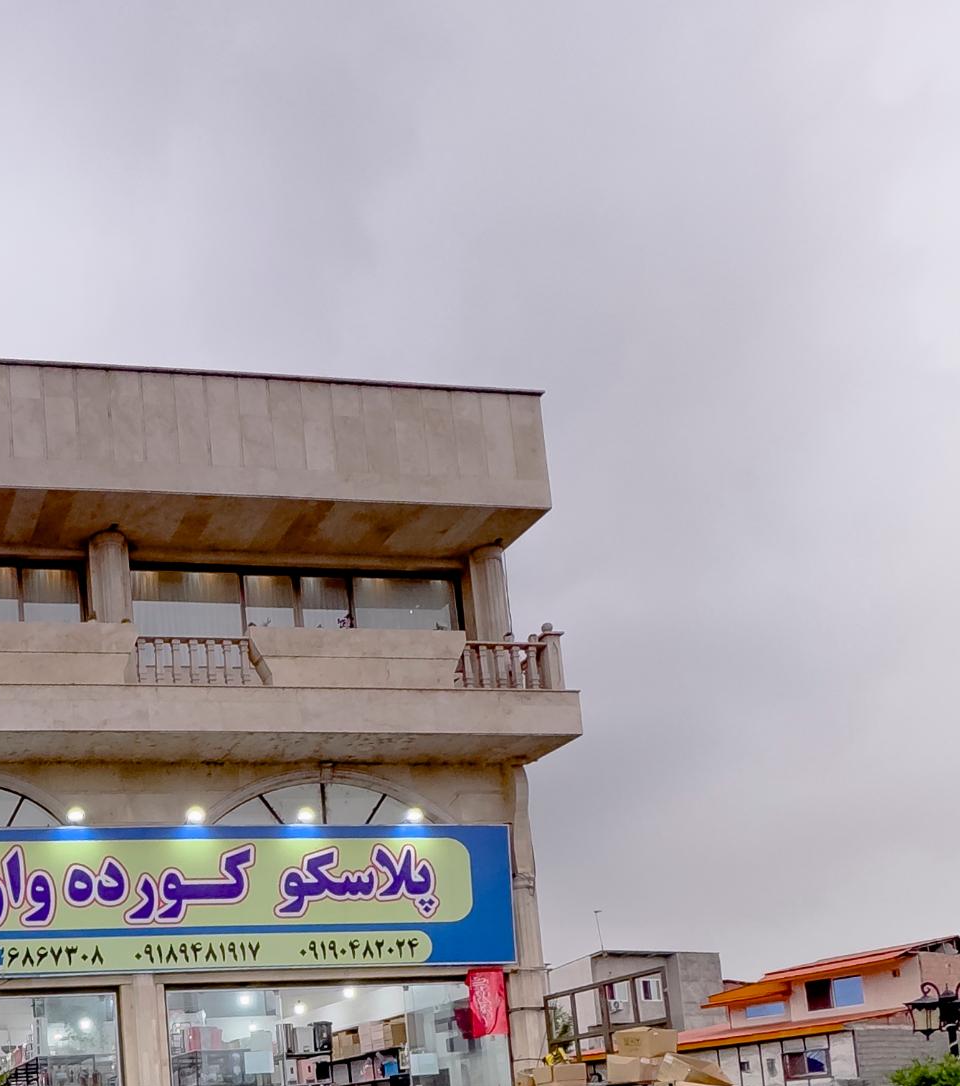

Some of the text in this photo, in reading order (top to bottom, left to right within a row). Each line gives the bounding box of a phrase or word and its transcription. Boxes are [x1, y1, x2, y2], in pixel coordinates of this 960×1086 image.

[276, 845, 437, 916] پلاسکو
[135, 941, 260, 964] ۰۹۱۸۹۴۸۱۹۱۷
[300, 938, 419, 960] ۰۹۱۹۰۴۸۲۰۲۴
